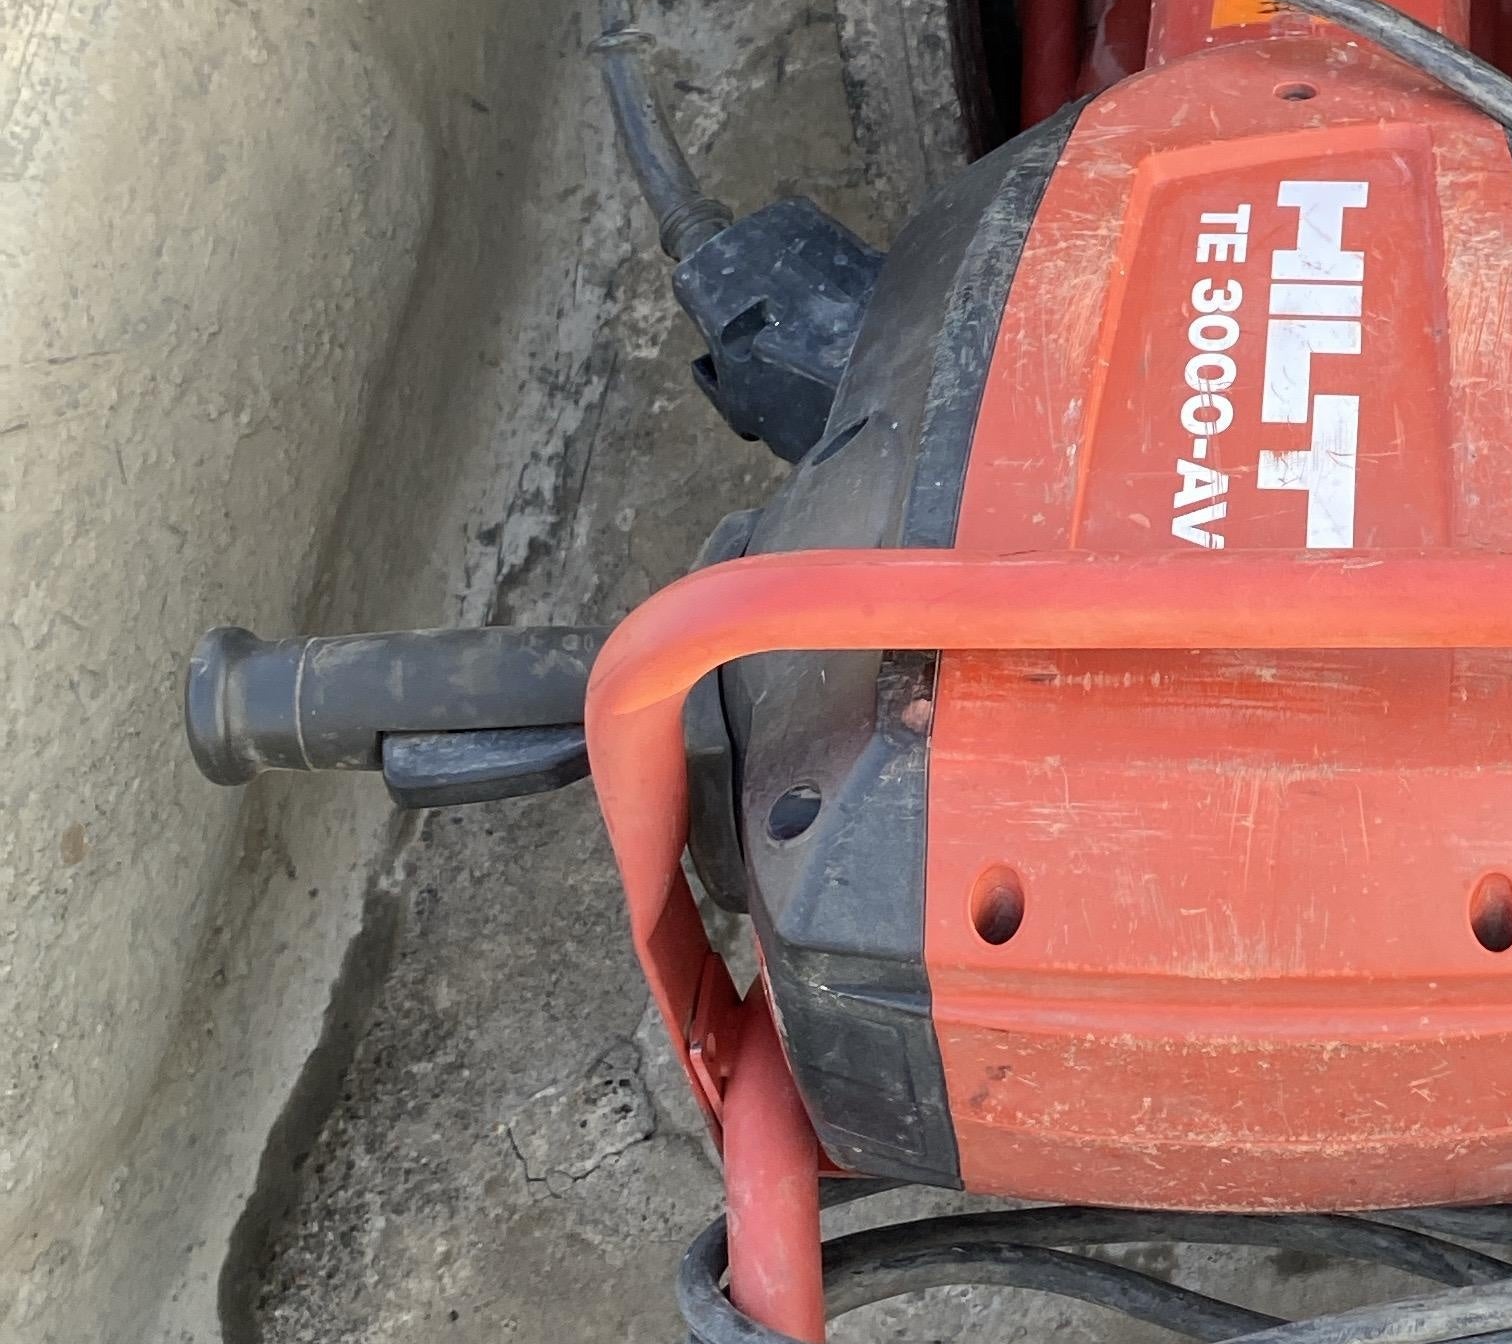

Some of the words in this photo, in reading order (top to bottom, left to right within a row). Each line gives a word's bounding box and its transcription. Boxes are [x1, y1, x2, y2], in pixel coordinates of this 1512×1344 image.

[1195, 203, 1252, 263] TE
[1256, 180, 1369, 549] HILT
[1171, 278, 1243, 549] 3000-AV
